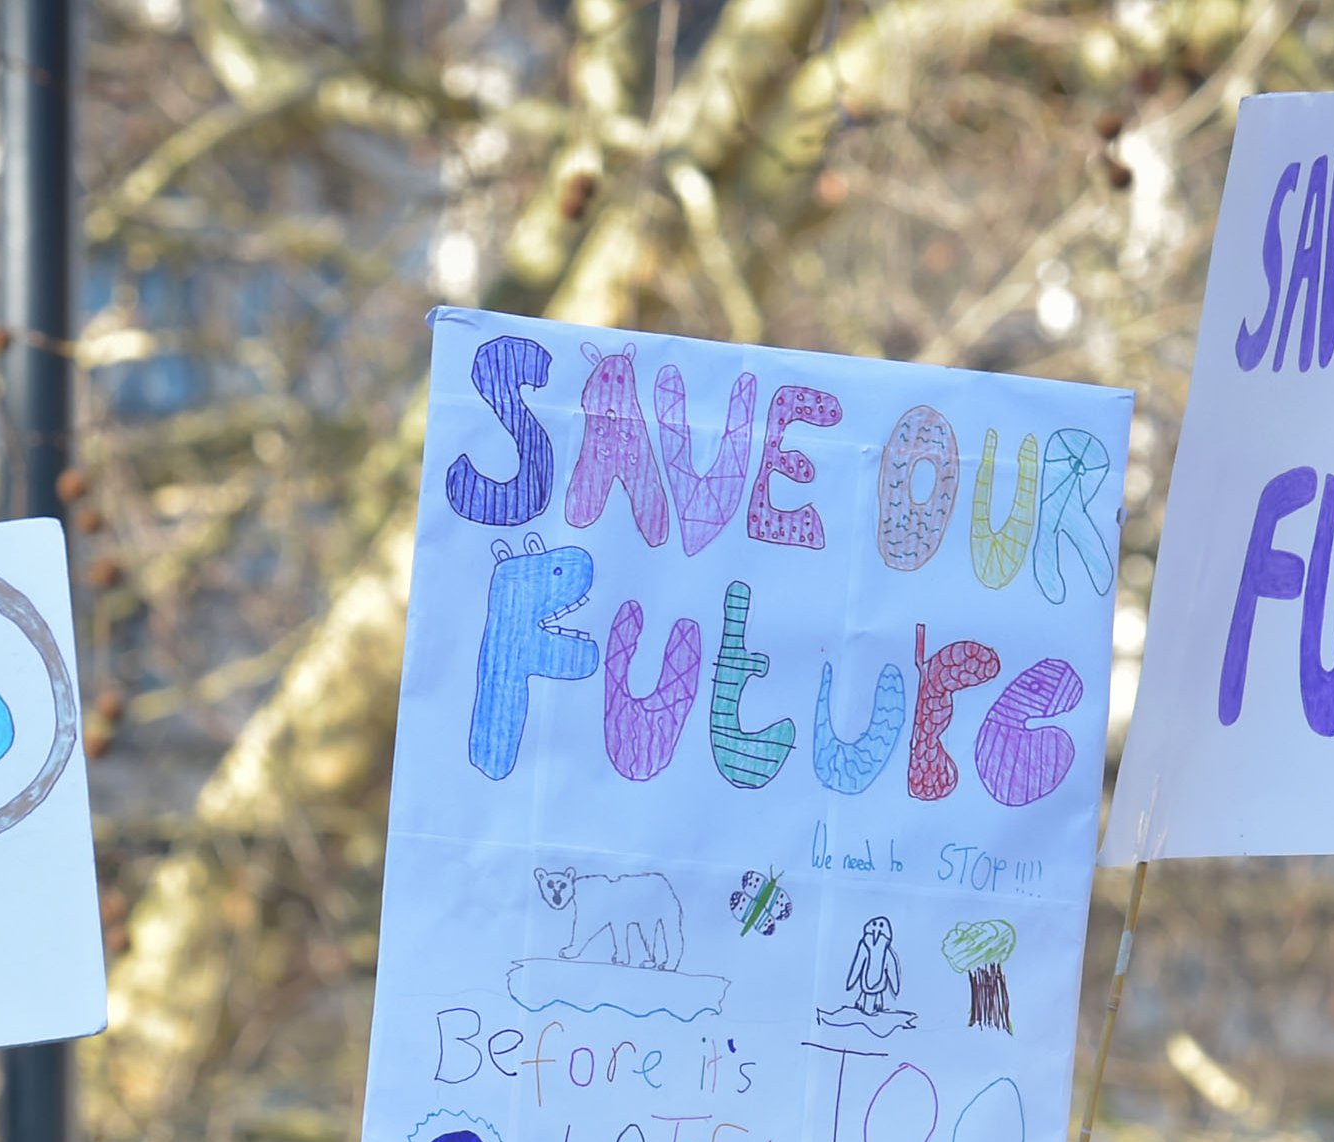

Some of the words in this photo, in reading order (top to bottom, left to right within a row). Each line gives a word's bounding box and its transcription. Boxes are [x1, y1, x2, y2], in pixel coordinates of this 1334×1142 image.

[446, 335, 843, 557] SAVE
[877, 404, 1113, 604] OUR
[812, 820, 832, 870] We
[843, 839, 875, 871] need
[891, 839, 904, 872] to
[434, 1008, 662, 1107] Before
[700, 1037, 756, 1093] it's
